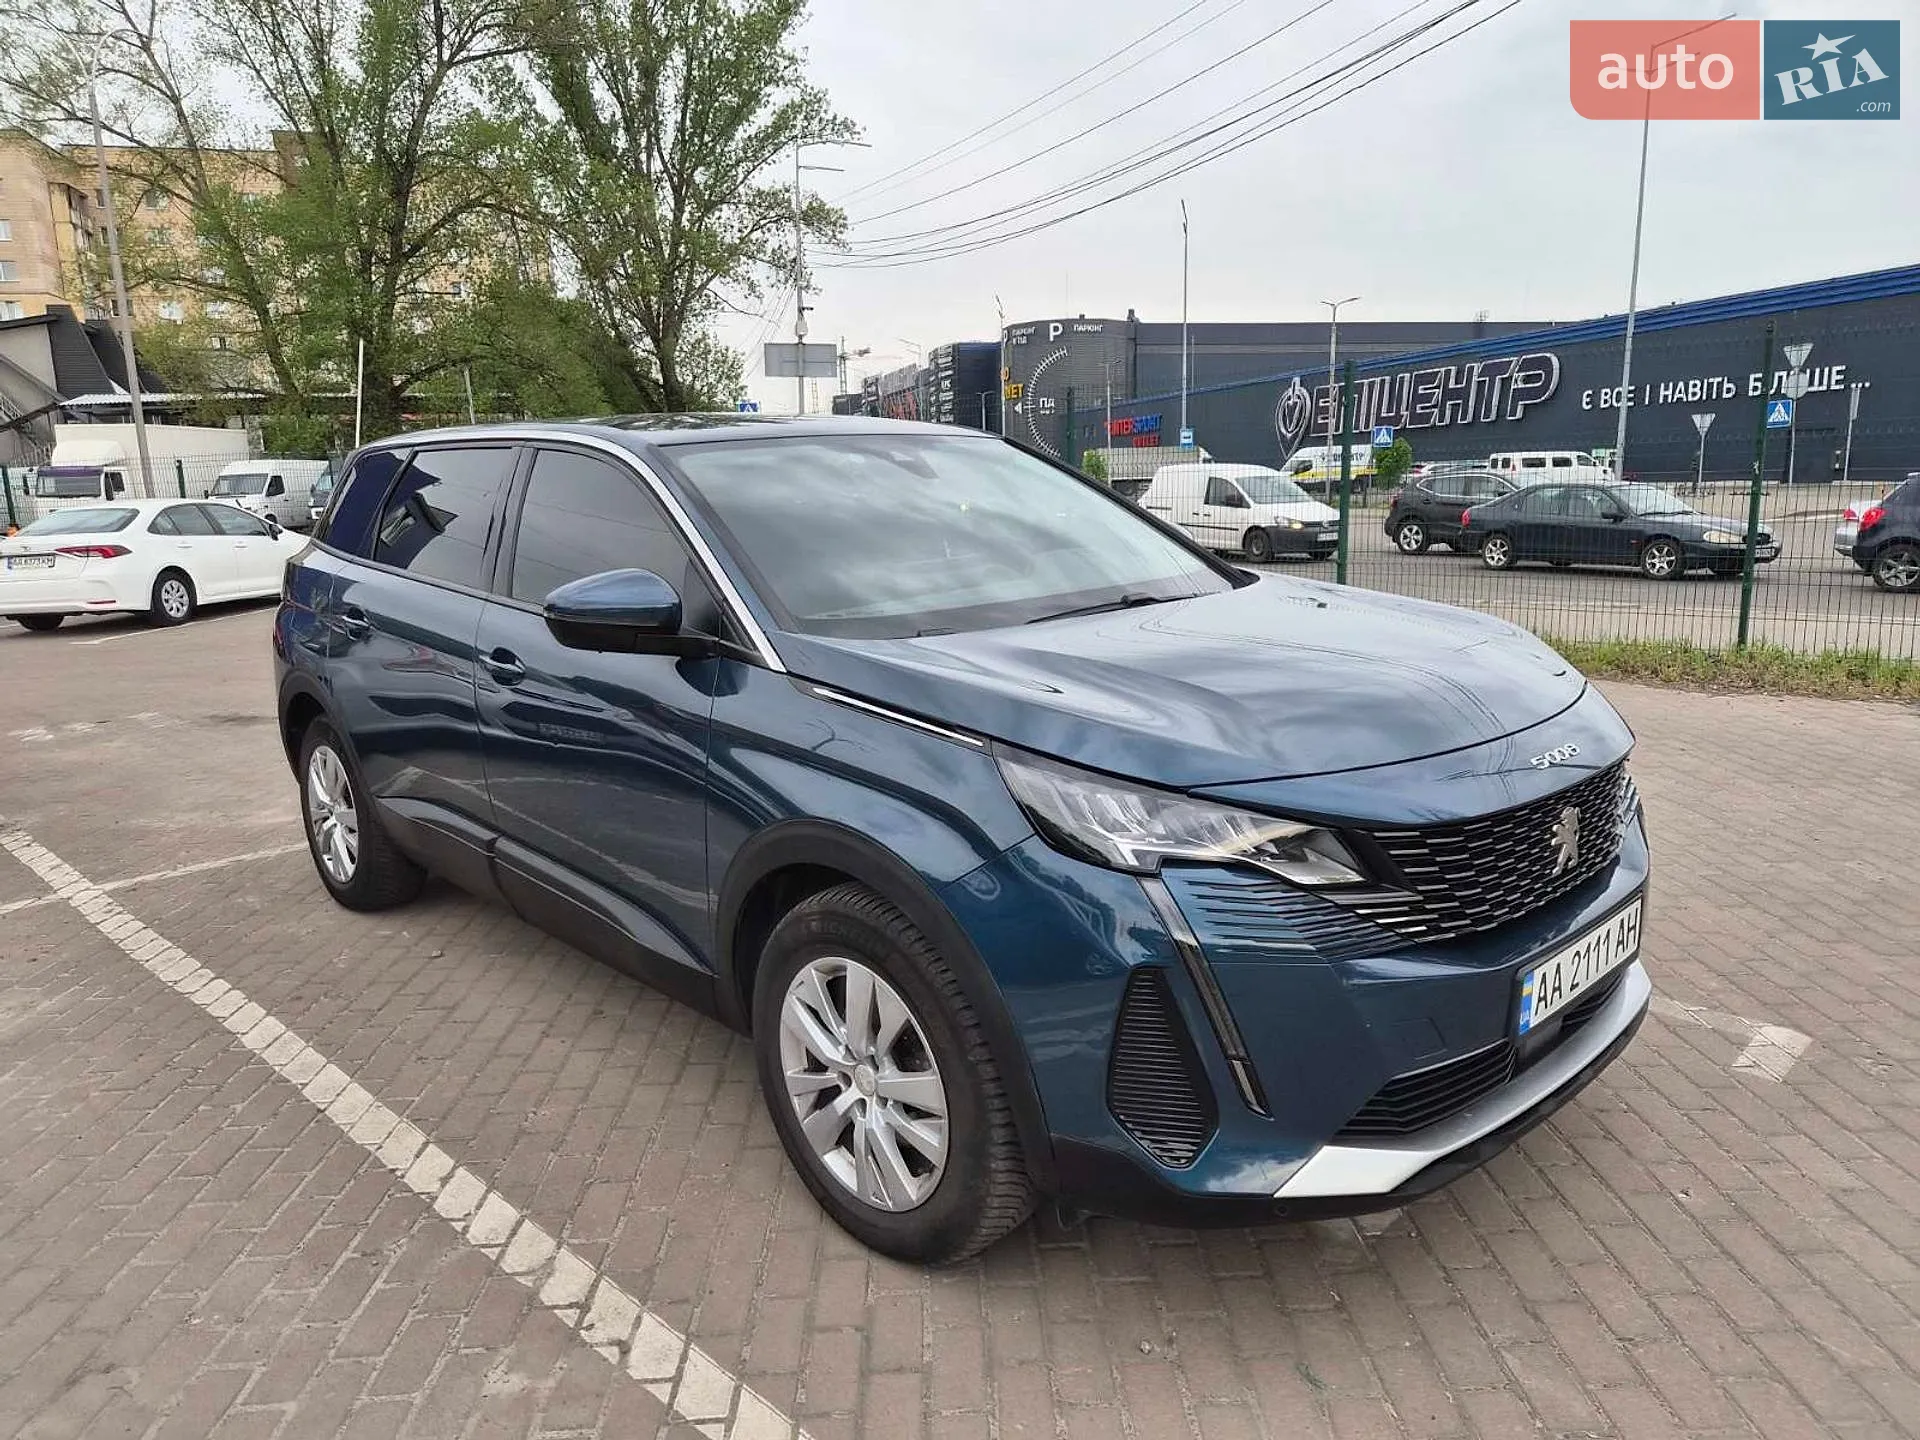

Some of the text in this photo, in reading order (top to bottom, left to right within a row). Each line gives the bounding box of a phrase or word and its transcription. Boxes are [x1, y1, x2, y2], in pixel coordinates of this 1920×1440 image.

[1049, 322, 1063, 342] P
[1659, 376, 1737, 404] НАВІТЬ
[1530, 743, 1580, 769] 5008
[1535, 907, 1639, 1016] AA 2111 AH
